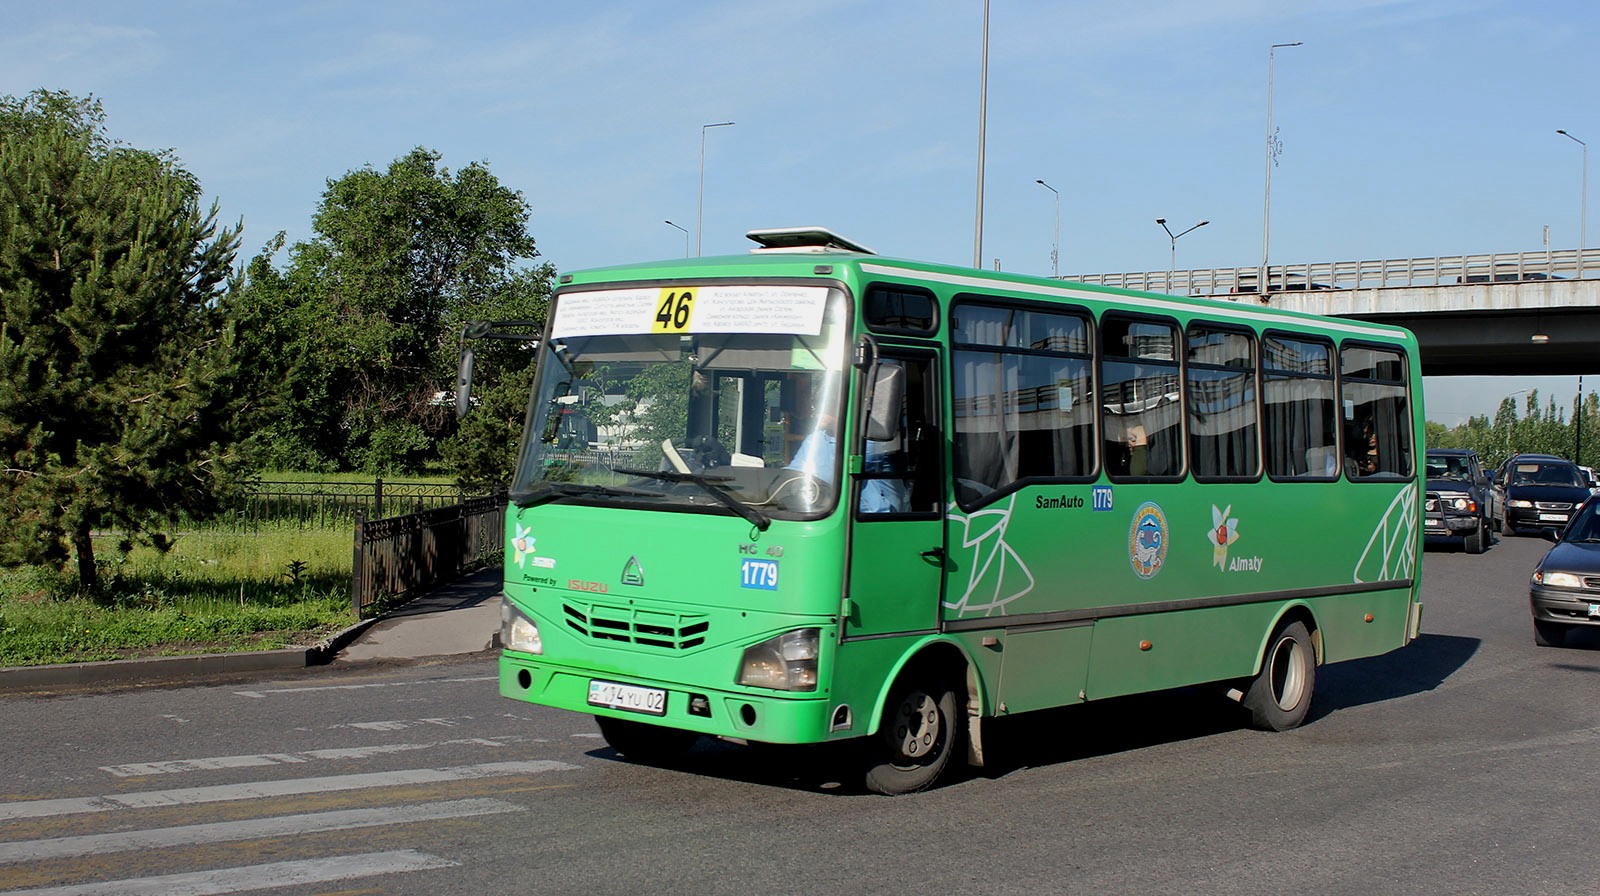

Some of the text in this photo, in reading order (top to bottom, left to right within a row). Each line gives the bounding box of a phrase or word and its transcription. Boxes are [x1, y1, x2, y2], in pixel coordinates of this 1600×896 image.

[656, 291, 692, 329] 46
[1035, 494, 1084, 509] SamAuto
[1092, 488, 1113, 508] 1779
[765, 545, 784, 557] 40
[1228, 555, 1264, 573] Almaty
[523, 573, 557, 586] Powered by
[741, 561, 778, 587] 1779
[567, 579, 608, 593] ISUZU
[627, 692, 641, 706] YU
[647, 692, 663, 710] 02
